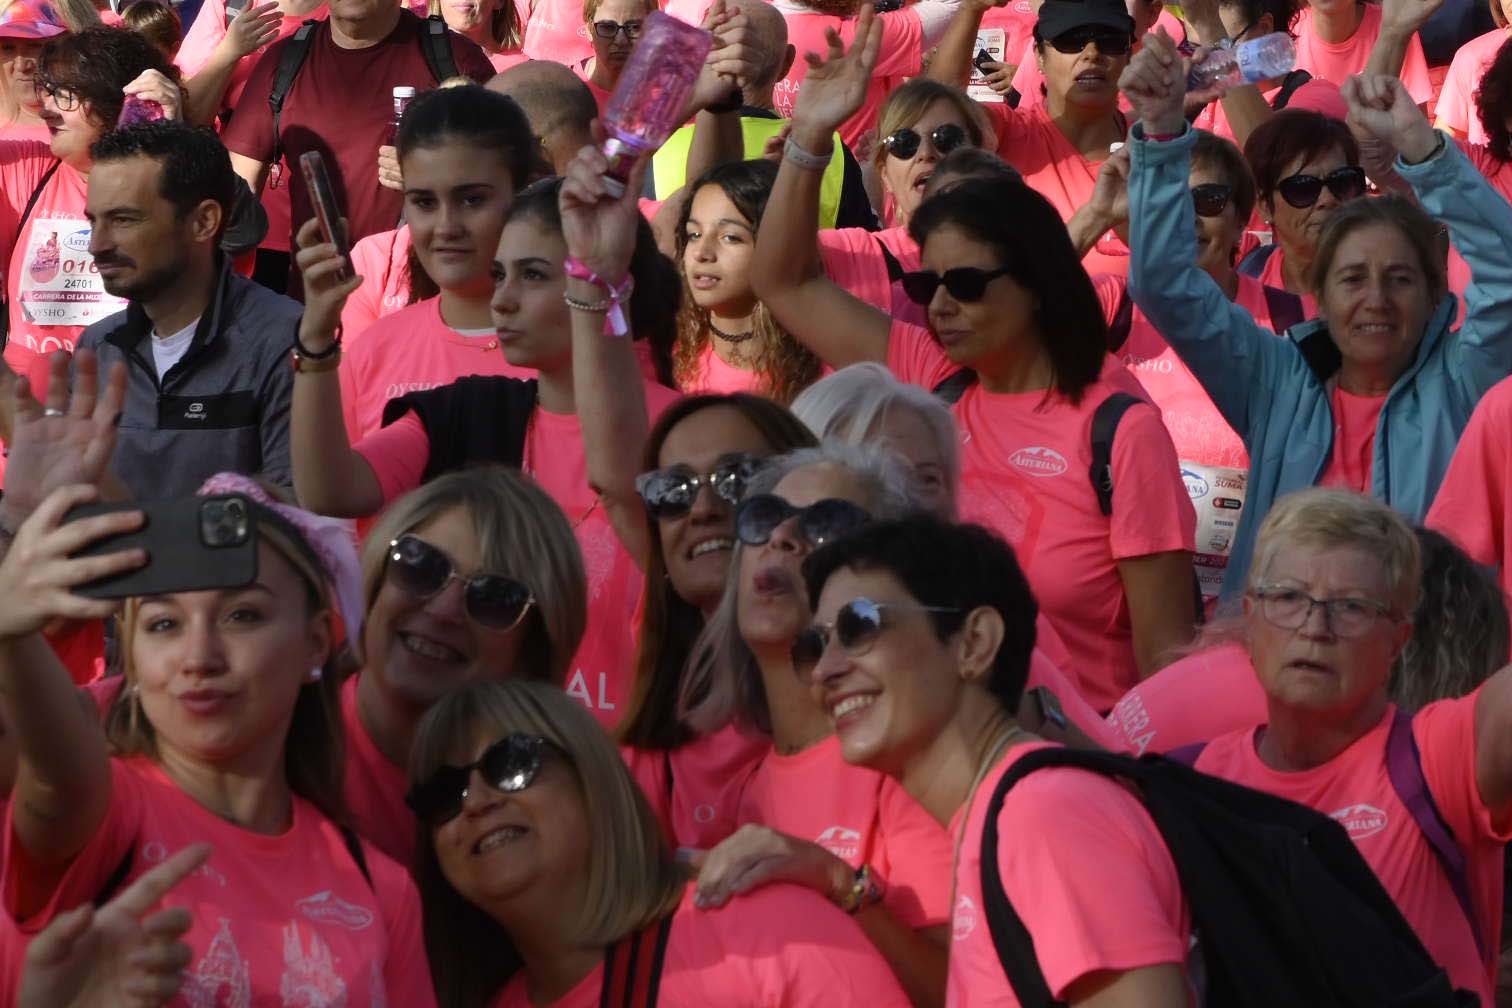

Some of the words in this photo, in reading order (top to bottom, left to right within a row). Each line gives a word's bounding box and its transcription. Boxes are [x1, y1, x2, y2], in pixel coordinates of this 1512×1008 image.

[776, 92, 793, 108] LA
[64, 279, 92, 289] 24701
[566, 669, 615, 711] AL
